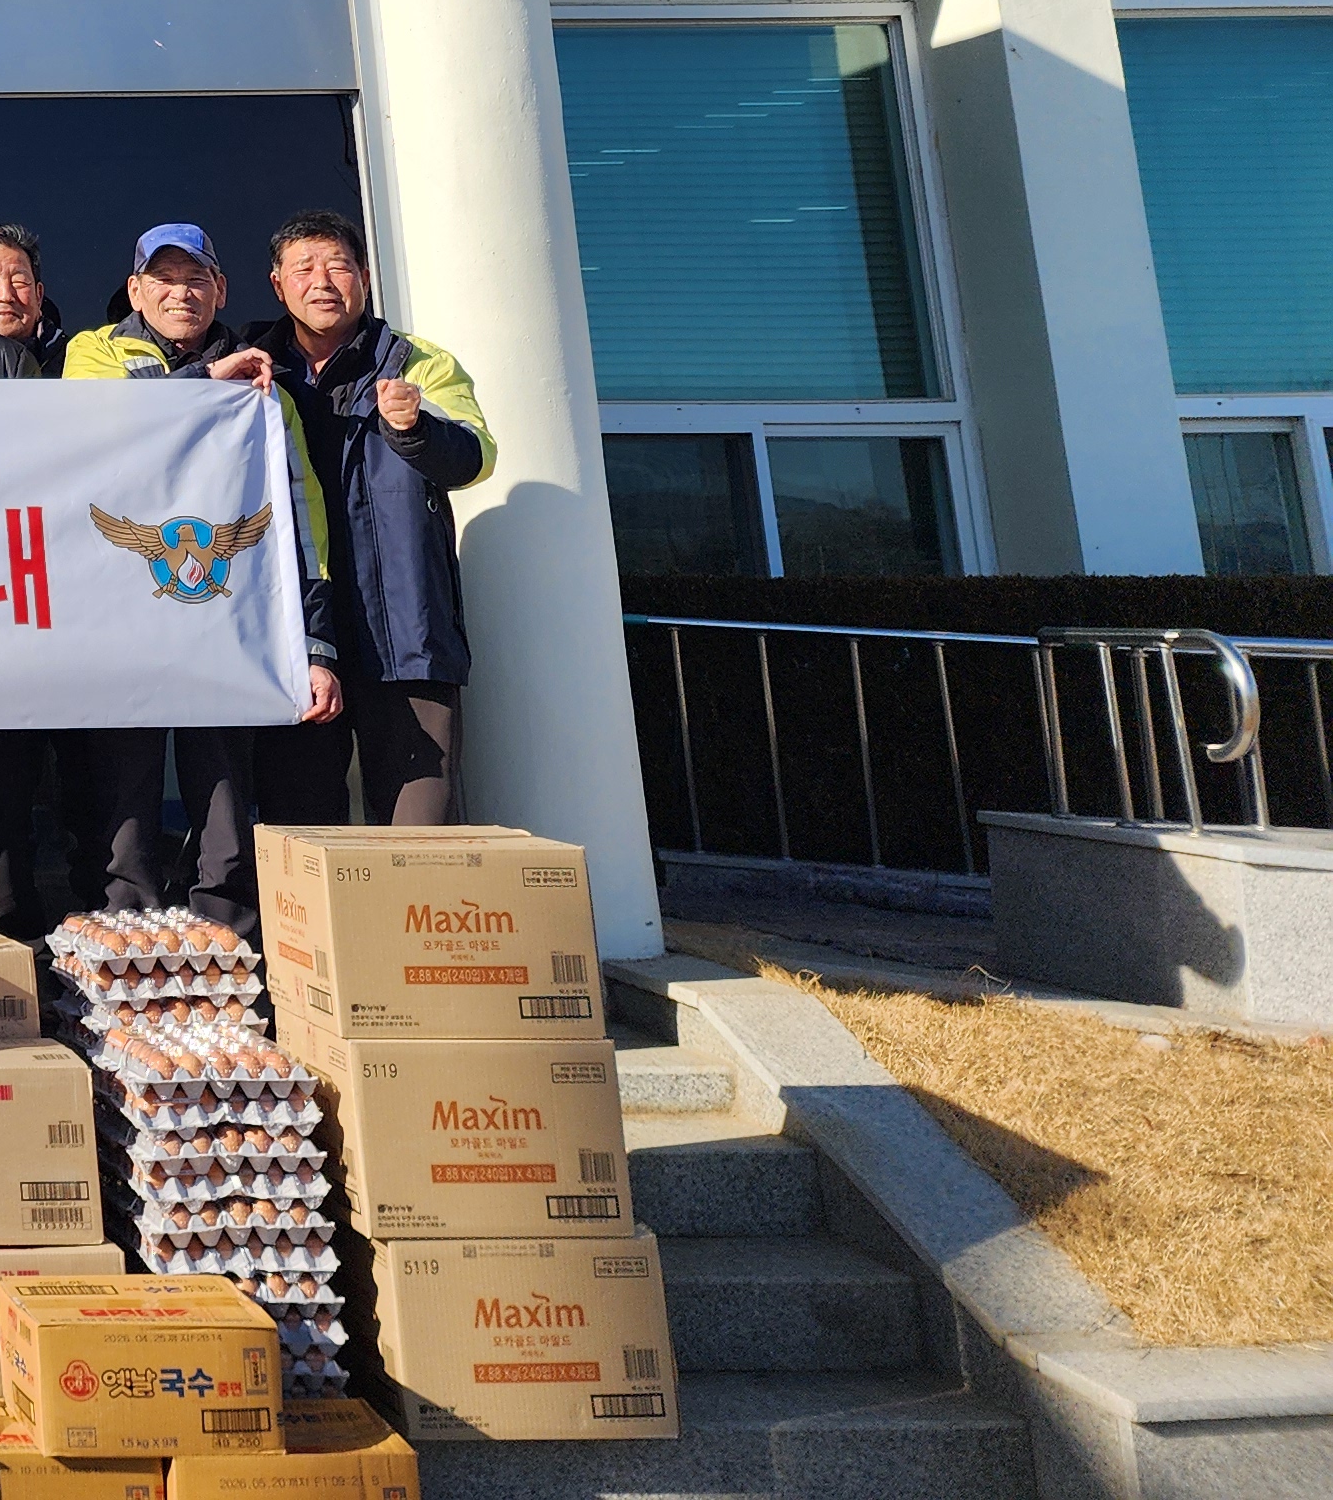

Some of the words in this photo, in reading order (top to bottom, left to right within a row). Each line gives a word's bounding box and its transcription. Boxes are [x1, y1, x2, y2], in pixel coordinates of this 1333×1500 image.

[336, 867, 371, 882] 5119
[275, 890, 308, 925] Maxim
[405, 899, 514, 934] Maxim
[423, 940, 465, 951] 모카골드
[469, 939, 501, 951] 마일드
[408, 969, 432, 983] 2.88
[363, 1063, 398, 1079] 5119
[432, 1095, 542, 1131] Maxim
[450, 1137, 493, 1150] 모카골드
[496, 1137, 529, 1149] 마일드
[404, 1259, 440, 1275] 5119
[474, 1291, 587, 1329] Maxim
[493, 1335, 535, 1347] 모카골드
